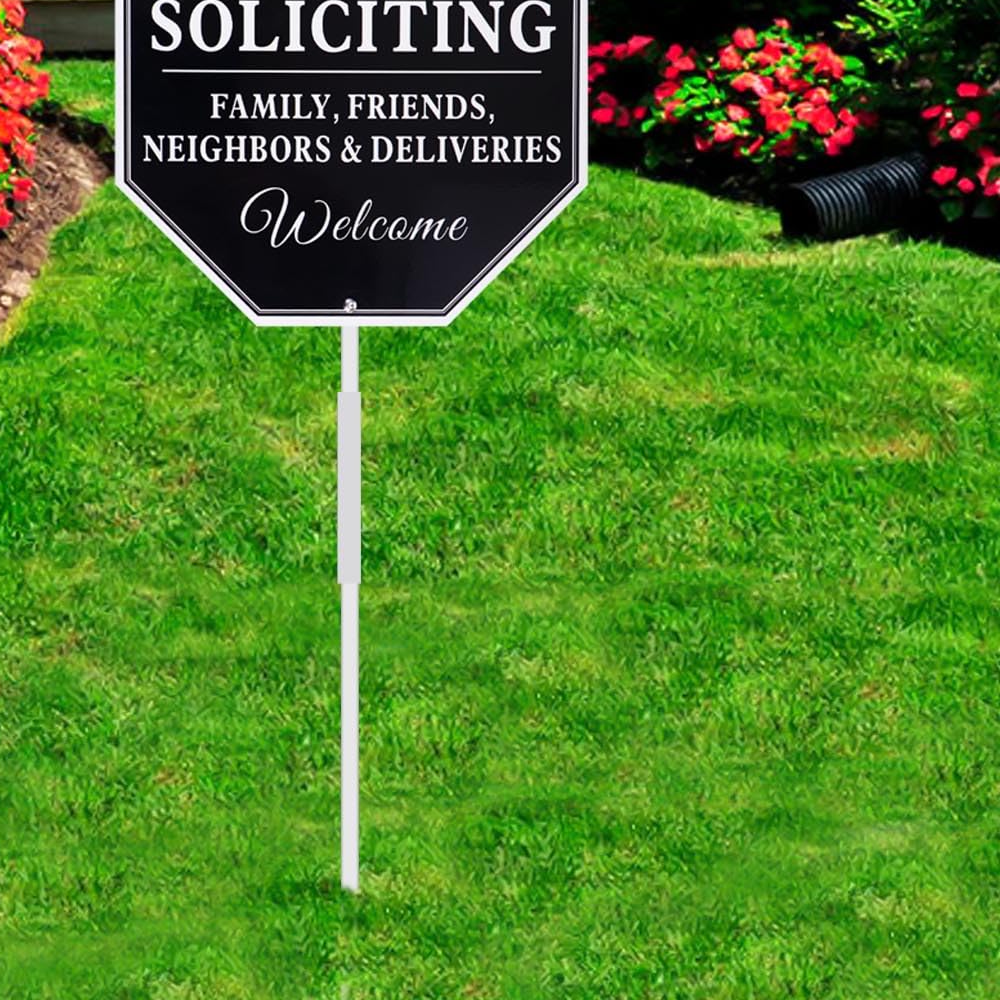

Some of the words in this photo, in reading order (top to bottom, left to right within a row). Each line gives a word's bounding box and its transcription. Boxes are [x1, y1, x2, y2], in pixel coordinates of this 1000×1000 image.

[210, 93, 339, 125] FAMILY,
[347, 93, 495, 125] FRIENDS,
[143, 134, 331, 163] NEIGHBORS
[341, 135, 362, 163] &
[370, 135, 562, 163] DELIVERIES
[239, 186, 469, 249] Welcome
